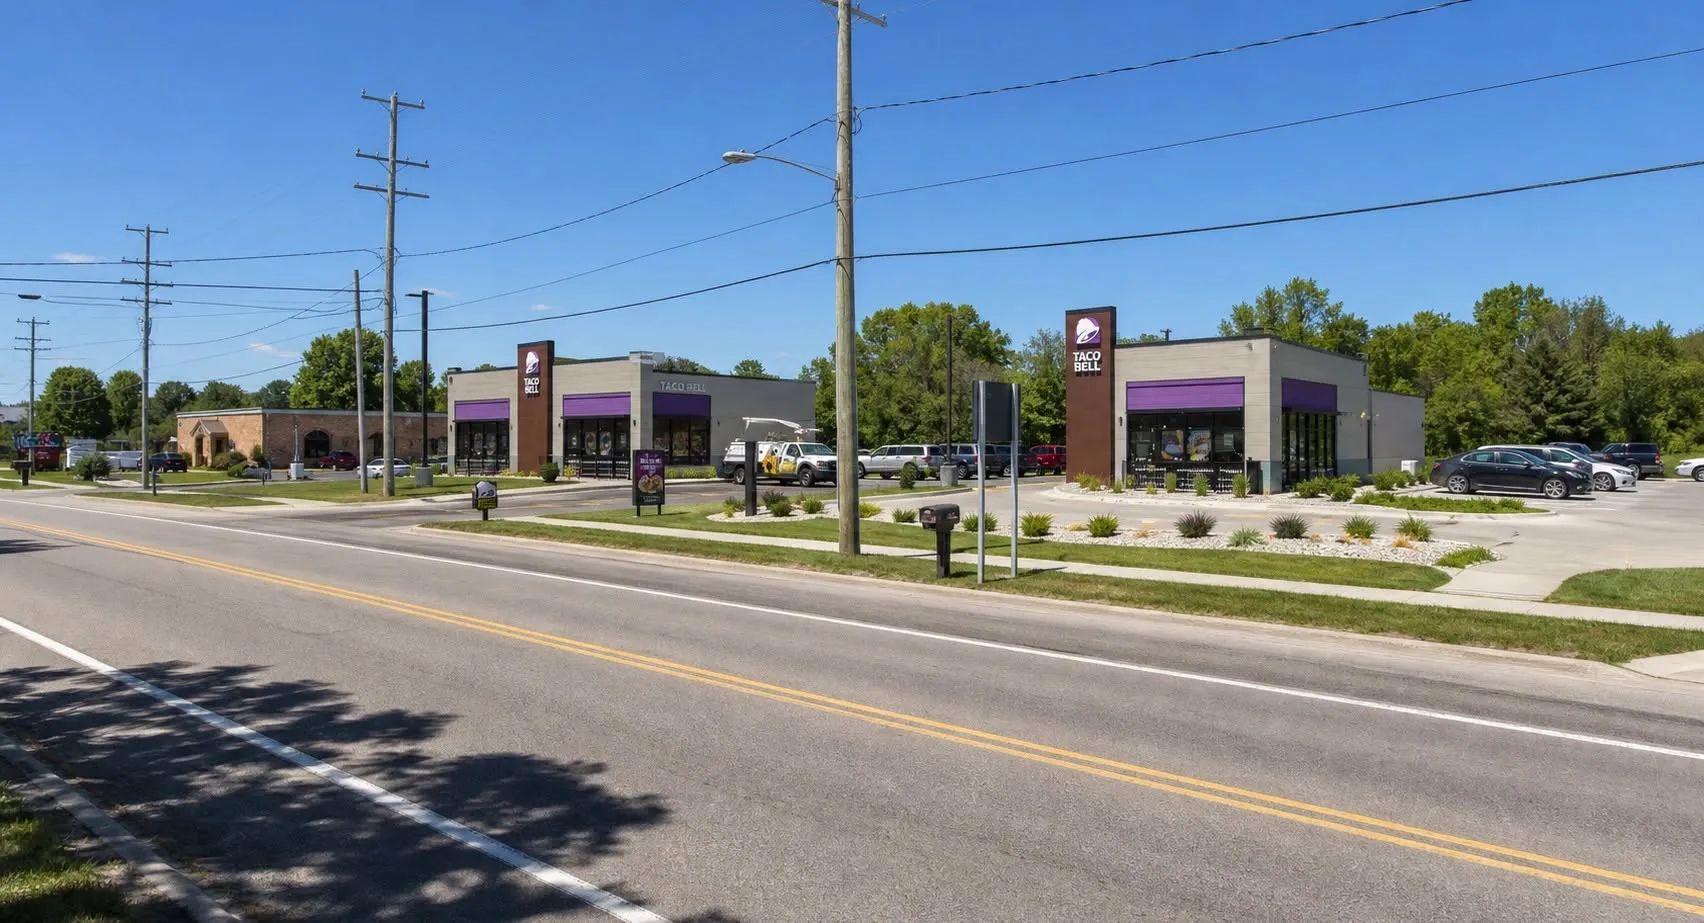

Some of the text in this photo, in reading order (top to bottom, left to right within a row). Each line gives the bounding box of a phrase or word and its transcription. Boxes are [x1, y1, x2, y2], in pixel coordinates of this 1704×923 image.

[1073, 351, 1101, 361] TACO
[1074, 361, 1101, 372] BELL
[524, 377, 540, 386] TACO
[660, 381, 707, 393] TACO BELL
